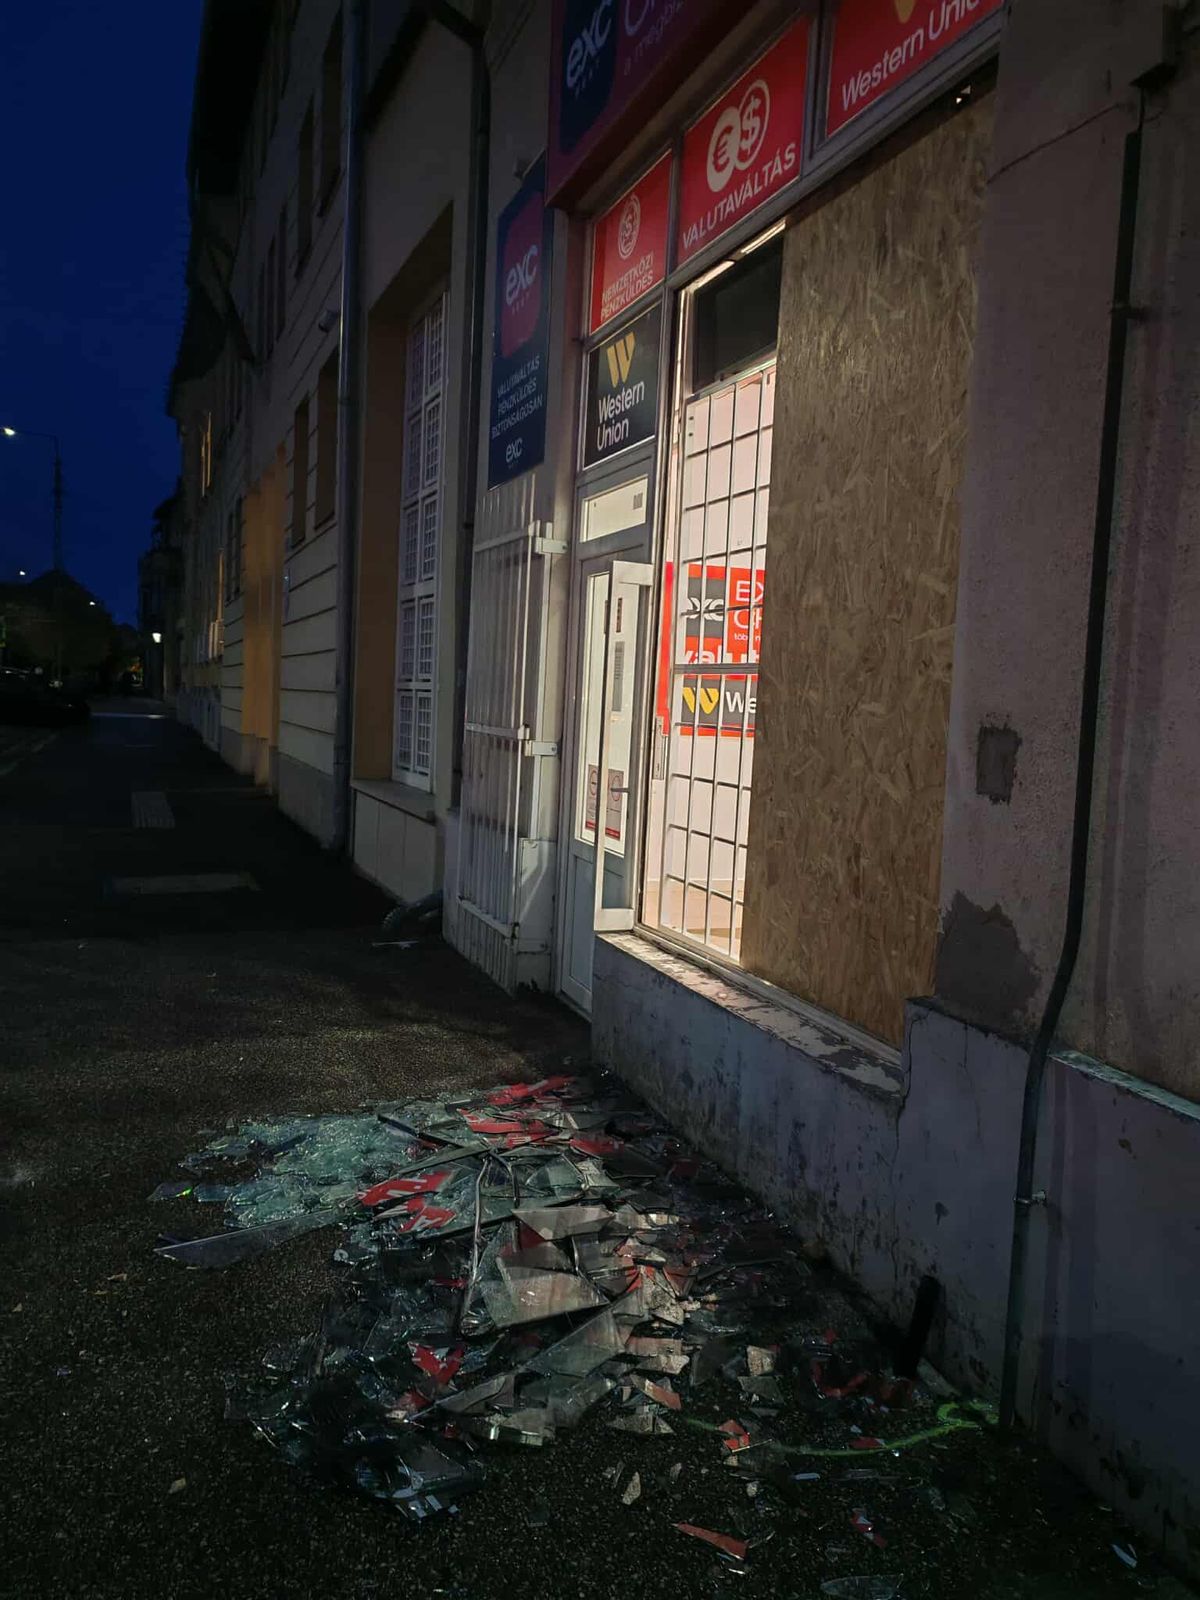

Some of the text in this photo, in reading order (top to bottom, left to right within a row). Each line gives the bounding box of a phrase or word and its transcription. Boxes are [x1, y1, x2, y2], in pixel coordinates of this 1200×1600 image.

[842, 28, 924, 111] Western
[682, 142, 796, 250] VALUTAVÁLTÁS
[506, 245, 539, 306] exc
[599, 381, 645, 424] Western
[505, 437, 523, 463] exc
[597, 418, 629, 452] Union
